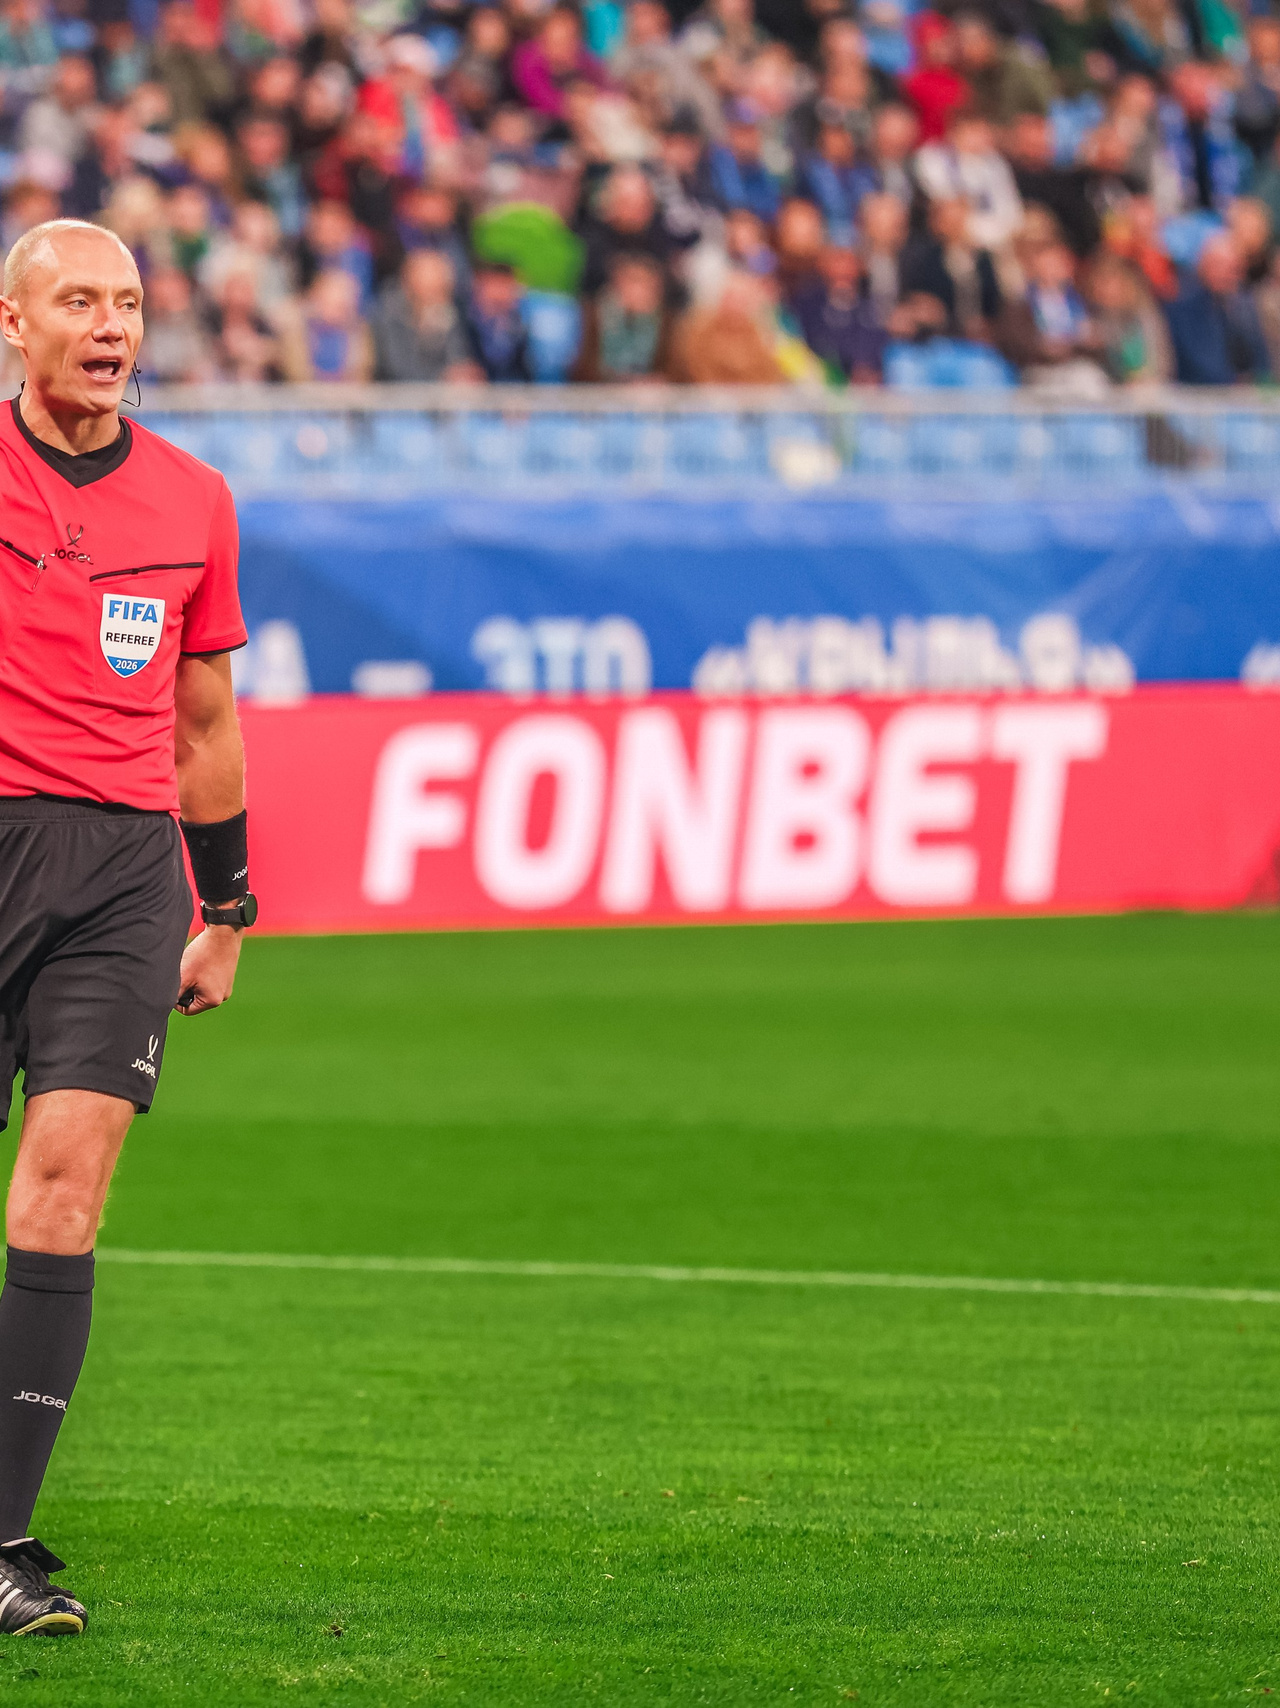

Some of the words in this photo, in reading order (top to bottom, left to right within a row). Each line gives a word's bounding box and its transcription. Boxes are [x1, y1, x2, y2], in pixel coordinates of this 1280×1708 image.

[108, 599, 158, 623] FIFA
[105, 631, 156, 647] REFEREE
[115, 659, 138, 671] 2026
[361, 703, 1110, 914] FONBET
